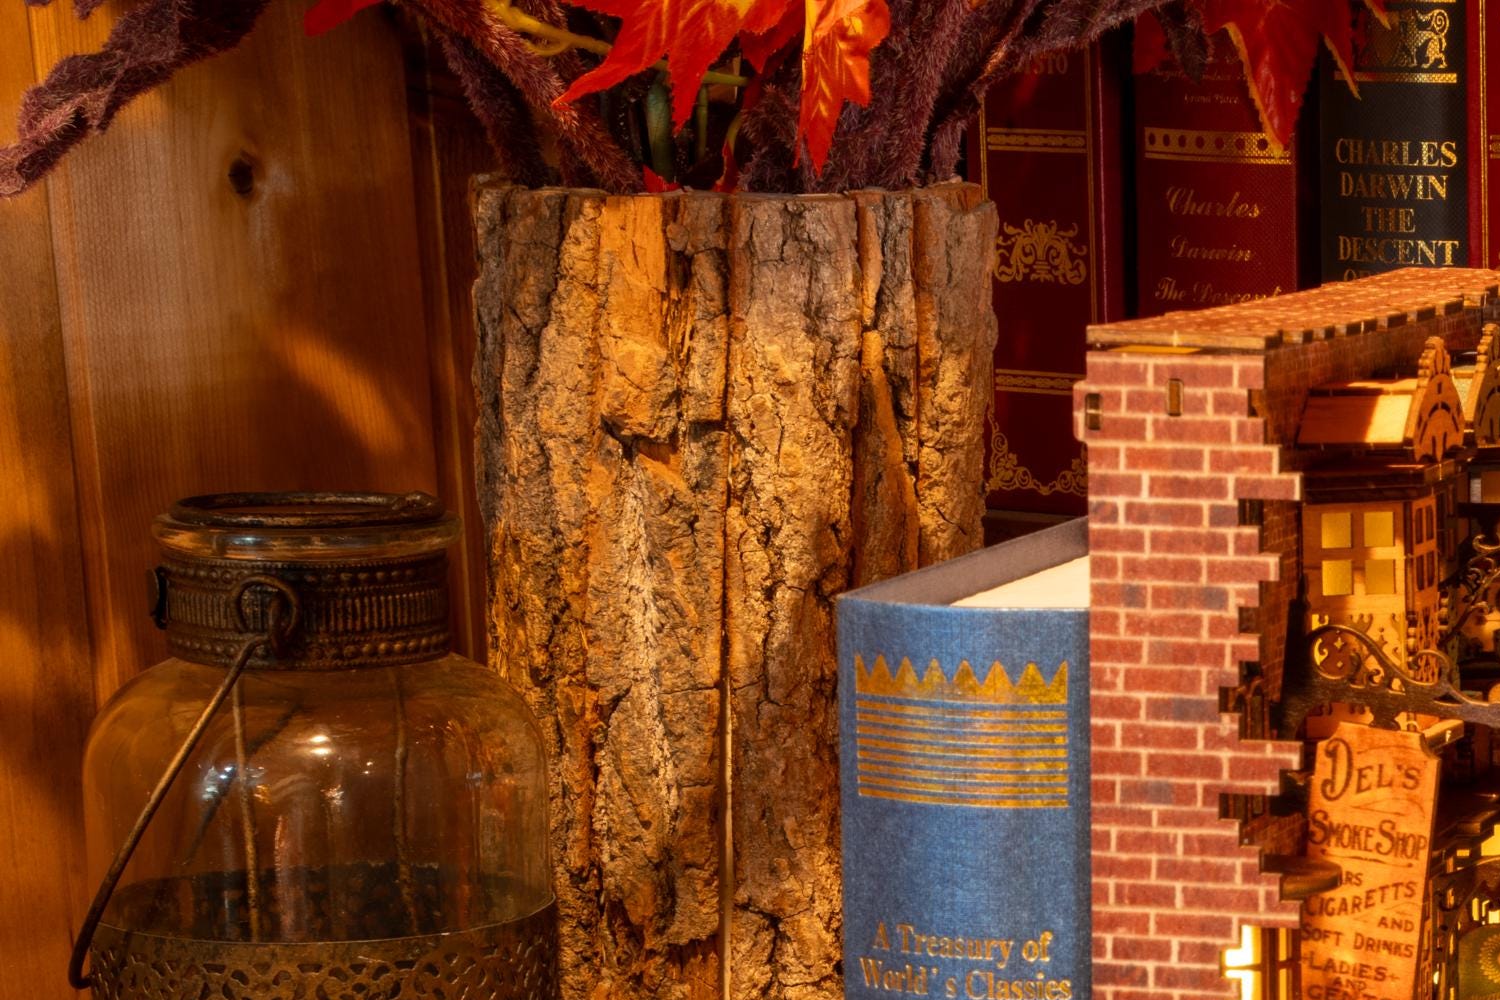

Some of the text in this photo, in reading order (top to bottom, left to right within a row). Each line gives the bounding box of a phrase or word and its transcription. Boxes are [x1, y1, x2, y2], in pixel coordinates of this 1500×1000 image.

[1336, 138, 1457, 167] CHARLES
[1341, 172, 1448, 200] DARWIN
[1166, 186, 1262, 218] Charles
[1361, 206, 1416, 233] THE
[1171, 234, 1253, 262] Darwin
[1338, 236, 1459, 266] DESCENT
[1154, 277, 1187, 301] The
[1321, 737, 1420, 801] DEL'S
[1309, 810, 1428, 861] SMOKE SHOP
[1377, 916, 1415, 933] AND
[872, 920, 1053, 969] A Treasury of
[1301, 922, 1414, 958] SOFT DRINKS
[1332, 977, 1368, 992] AND
